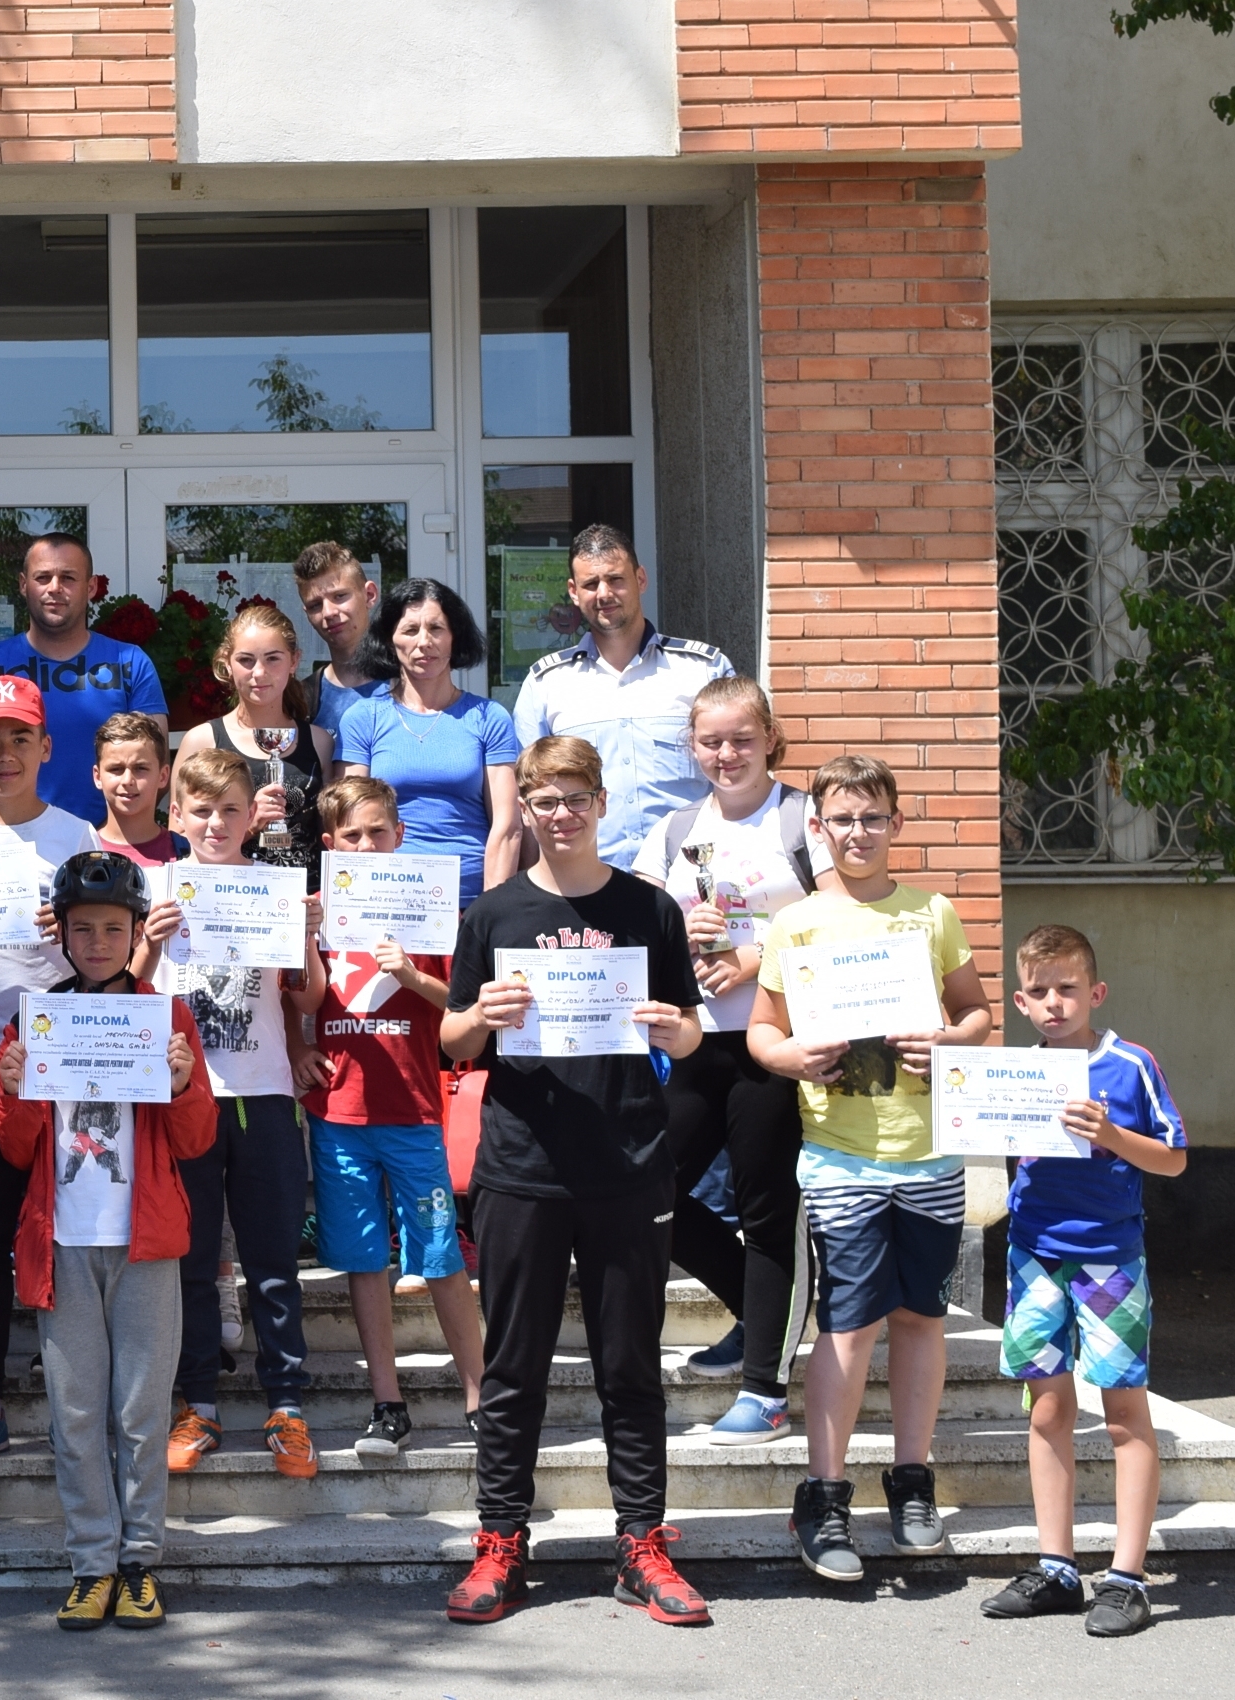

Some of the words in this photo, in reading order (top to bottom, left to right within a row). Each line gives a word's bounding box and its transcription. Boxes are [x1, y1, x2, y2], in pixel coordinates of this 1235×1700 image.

[264, 836, 283, 844] LOCUL
[371, 872, 424, 883] DIPLOMĂ
[215, 884, 269, 895] DIPLOMĂ
[558, 927, 580, 947] The
[832, 949, 890, 966] DIPLOMĂ
[548, 969, 606, 981] DIPLOMĂ
[72, 1015, 130, 1026] DIPLOMĂ
[324, 1018, 411, 1036] CONVERSE
[987, 1069, 1046, 1080] DIPLOMĂ
